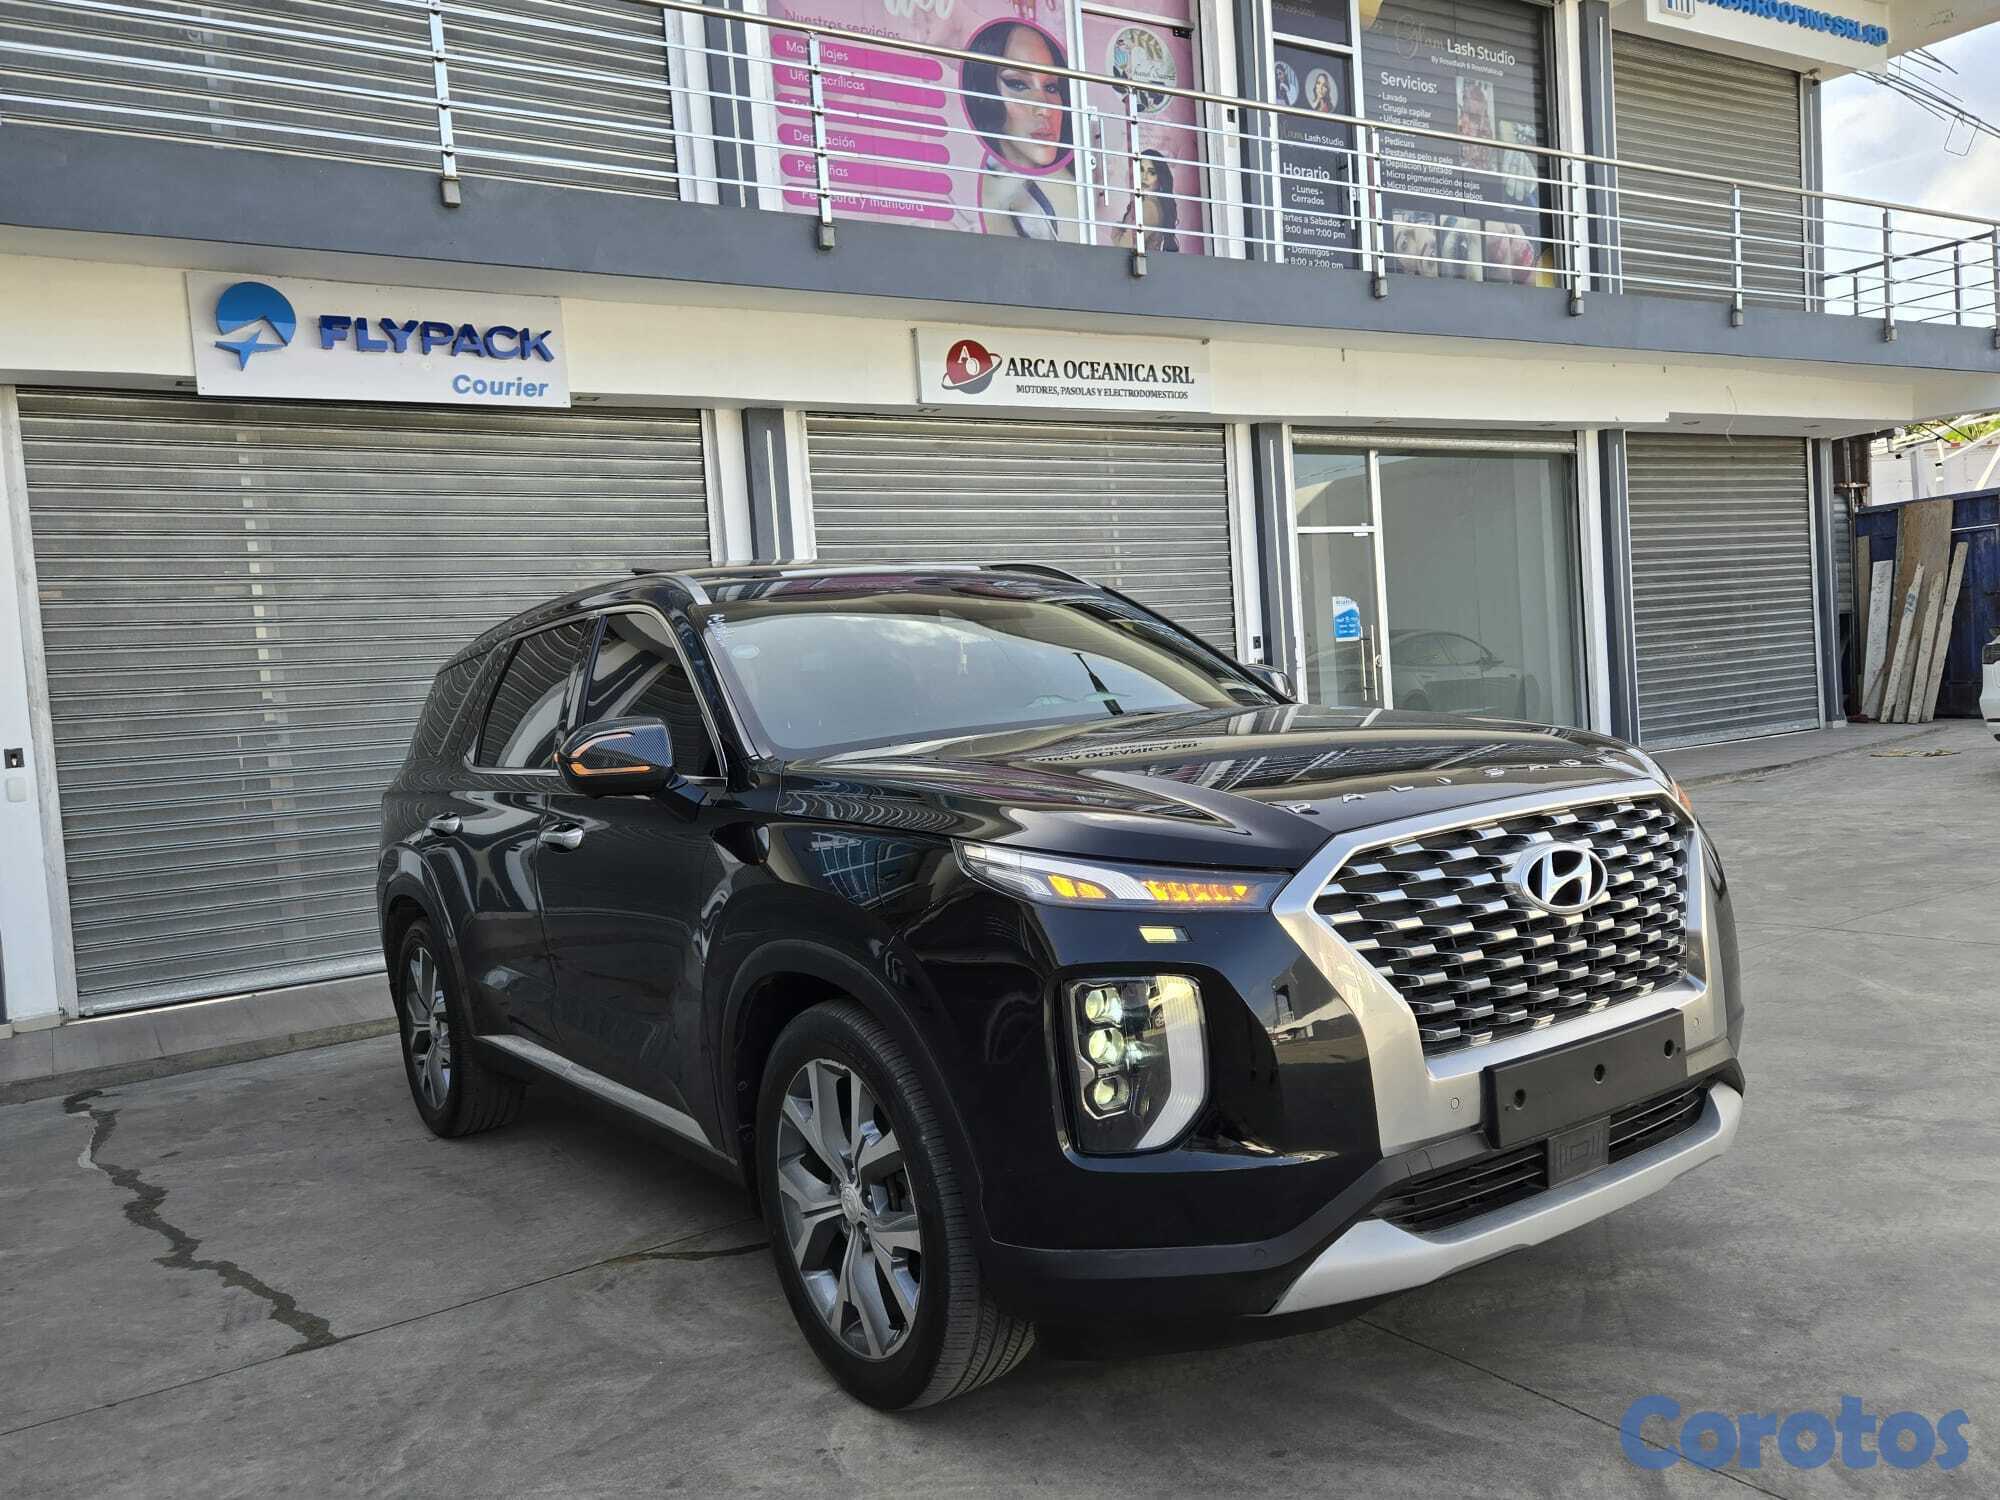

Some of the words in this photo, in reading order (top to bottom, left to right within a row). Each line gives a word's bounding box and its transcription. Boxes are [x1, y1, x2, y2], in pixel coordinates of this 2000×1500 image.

[785, 40, 849, 63] Mallajes
[1447, 38, 1476, 57] Lash
[1477, 46, 1516, 66] Studio
[1380, 72, 1438, 94] Servicios:
[1304, 132, 1321, 144] Lash
[1321, 135, 1345, 147] Studio
[797, 159, 849, 177] Pesñas
[1282, 161, 1331, 181] Horario
[1296, 184, 1319, 195] Lunes
[1291, 193, 1325, 206] Cerrados
[1284, 214, 1303, 223] artes
[1285, 224, 1301, 234] 9:00
[318, 315, 555, 363] FLYPACK
[1005, 357, 1058, 379] ARCA
[1063, 359, 1159, 383] OCEANICA
[1162, 365, 1195, 384] SRL
[452, 374, 550, 398] Courier
[1016, 384, 1060, 396] MOTORES,
[1060, 386, 1097, 397] PASOLAS
[1103, 388, 1189, 400] ELECTRODOMESTICOS
